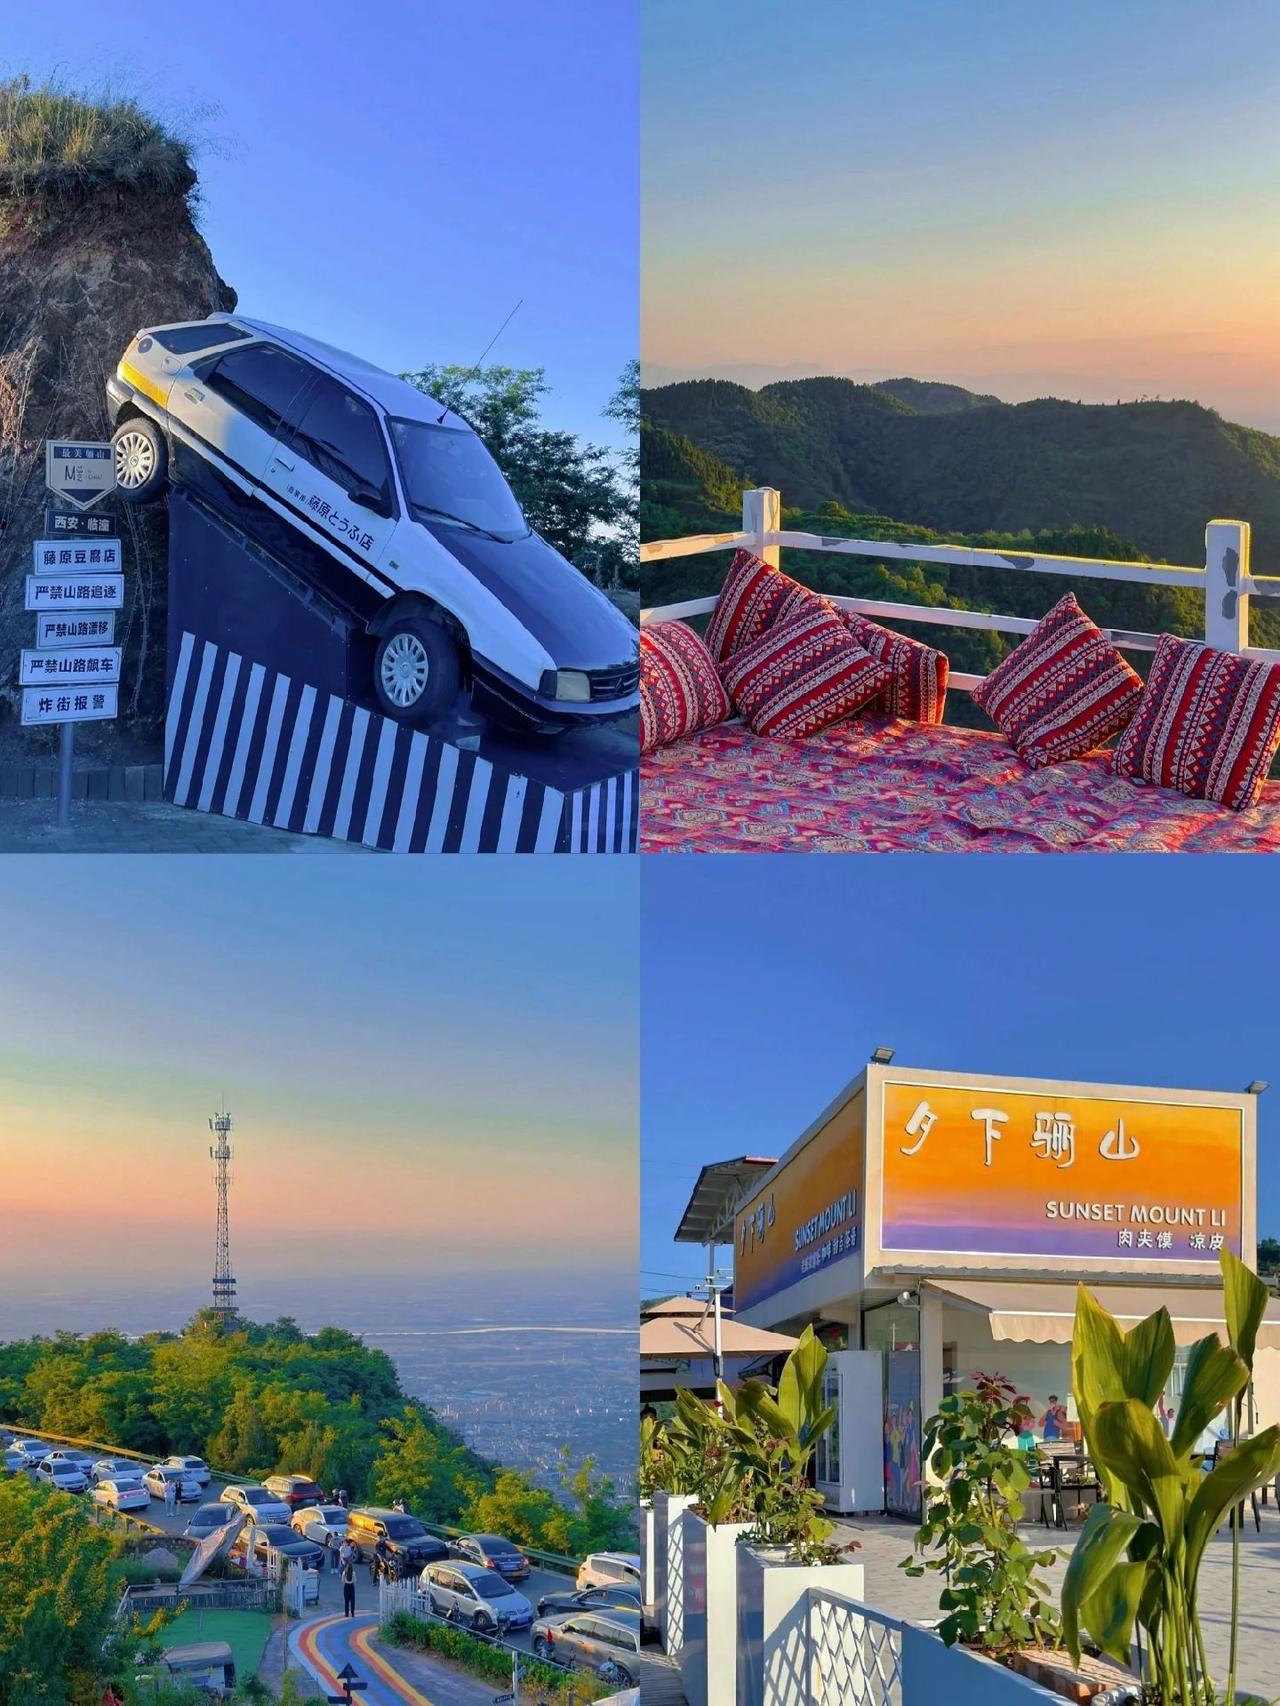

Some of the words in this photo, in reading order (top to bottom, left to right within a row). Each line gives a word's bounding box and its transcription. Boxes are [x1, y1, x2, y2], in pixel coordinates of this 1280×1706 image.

[43, 549, 116, 565] 藤原豆腐店
[35, 585, 117, 600] 严禁山路追逐
[45, 621, 109, 638] 严禁山路漂移
[30, 658, 113, 674] 严禁山路飙车
[38, 694, 105, 713] 炸街报警
[900, 1101, 1140, 1169] 夕下骊山
[1046, 1200, 1125, 1222] SUNSET
[1130, 1205, 1206, 1226] MOUNT
[1210, 1209, 1226, 1227] LI
[1118, 1228, 1174, 1250] 肉夹馍
[1189, 1232, 1225, 1251] 凉皮
